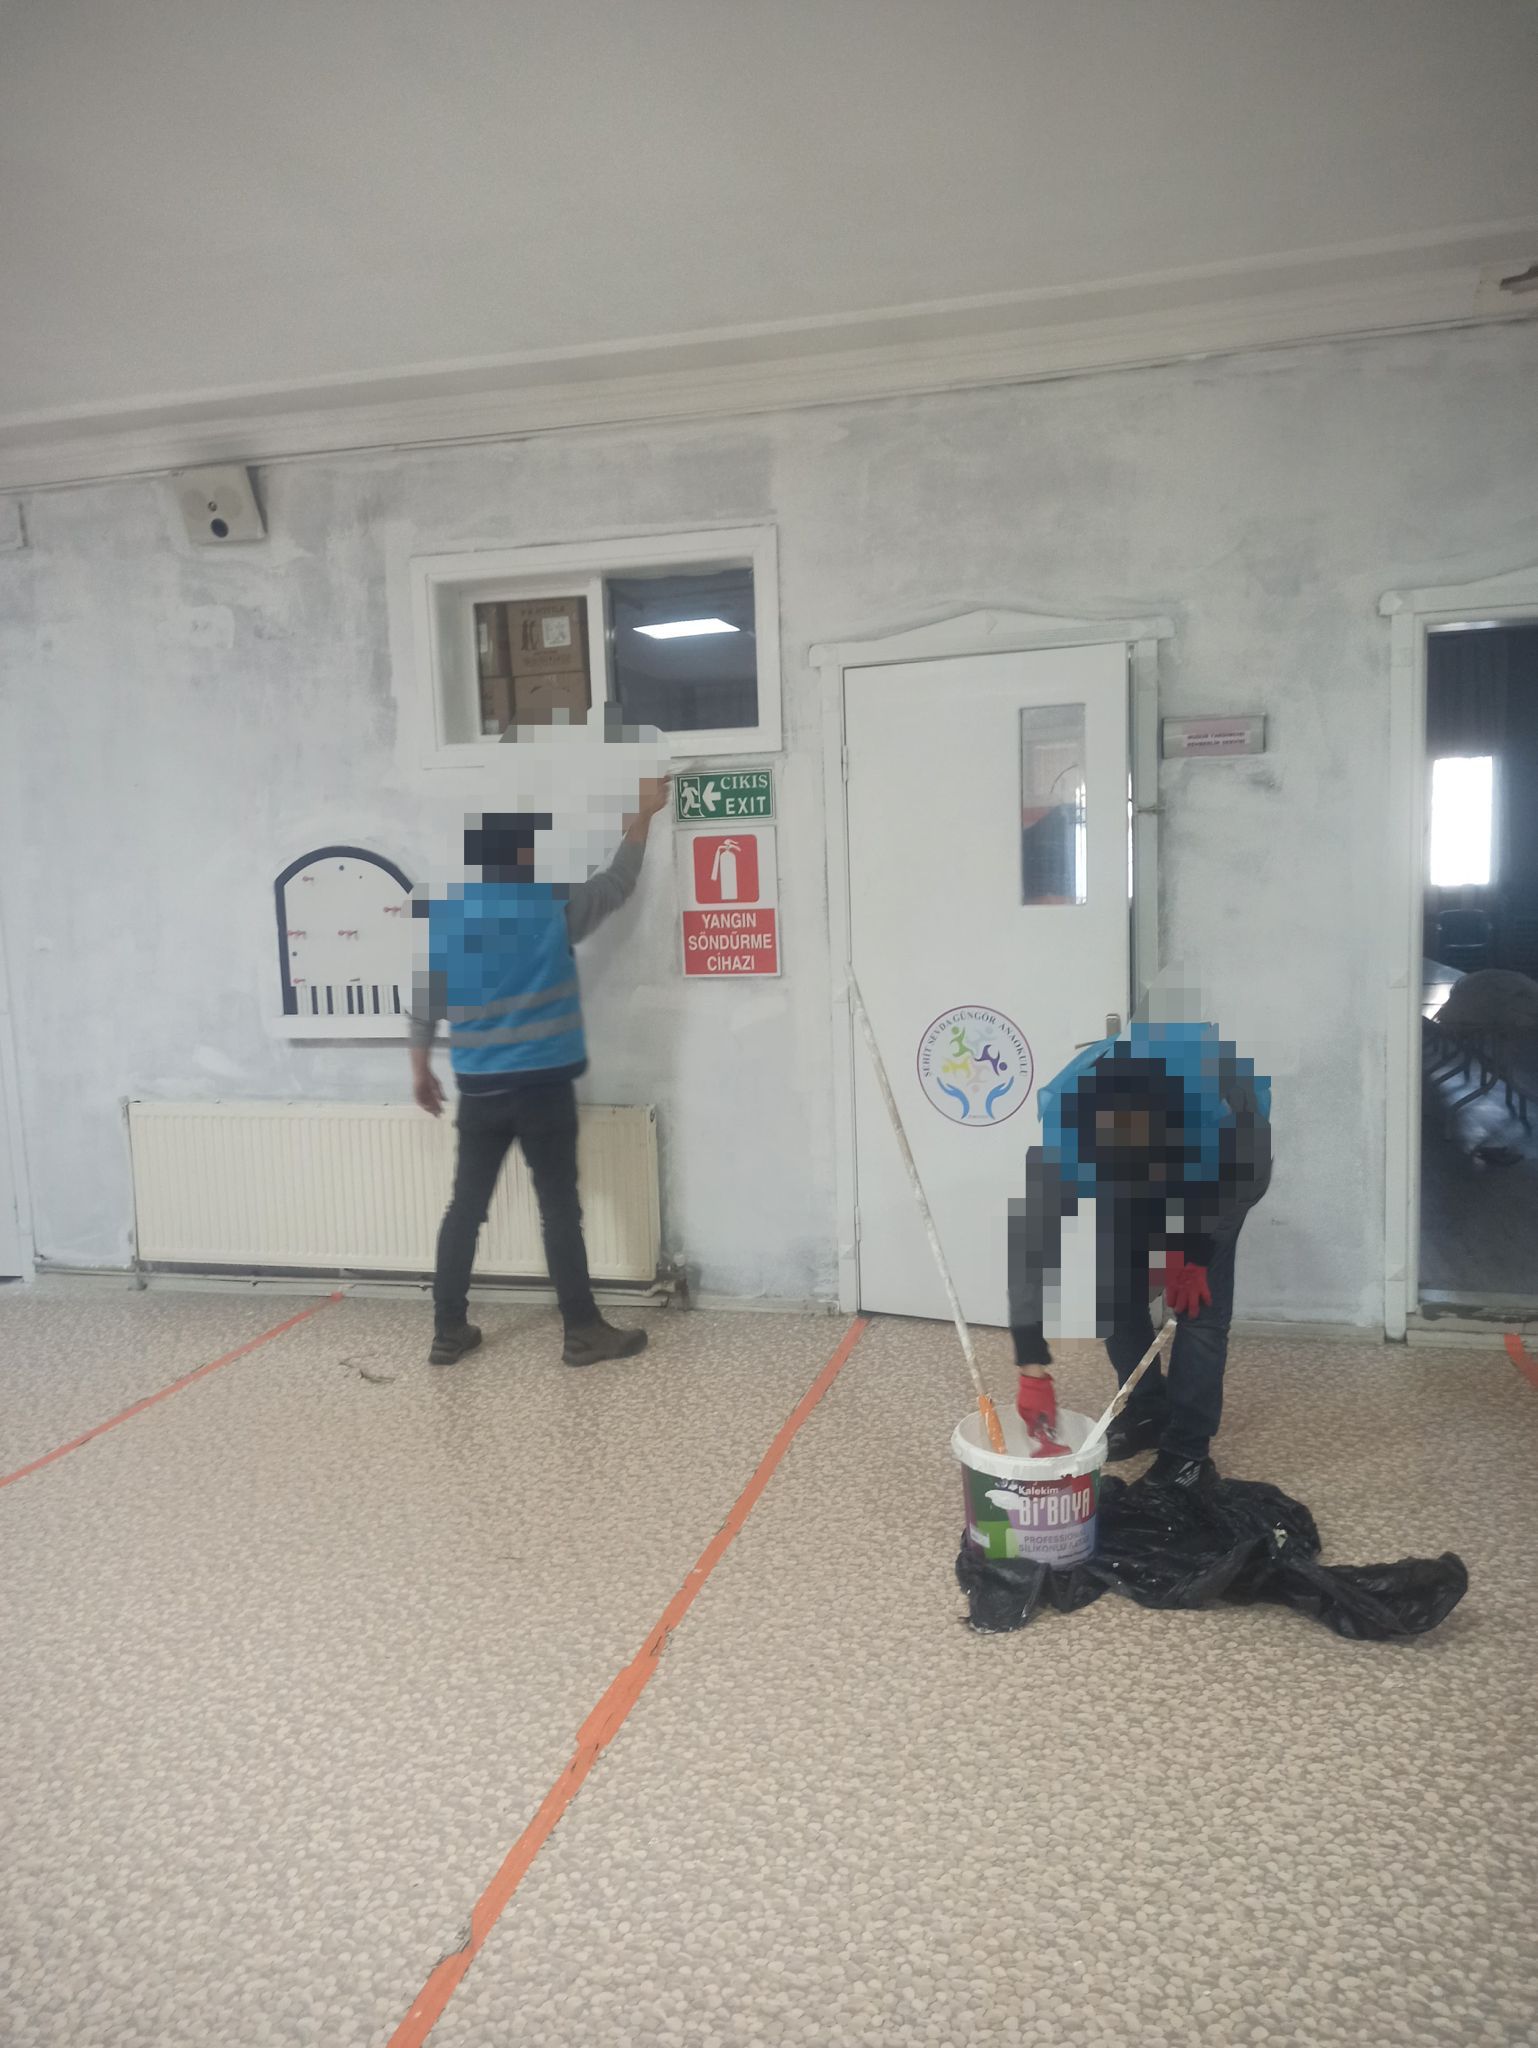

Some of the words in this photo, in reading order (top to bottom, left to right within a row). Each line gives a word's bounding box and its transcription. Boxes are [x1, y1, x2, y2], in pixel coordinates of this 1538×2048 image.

[725, 796, 767, 815] EXIT
[701, 912, 757, 929] YANGIN
[688, 930, 773, 951] SÖNDÜRME
[1018, 1486, 1059, 1495] Kalekim
